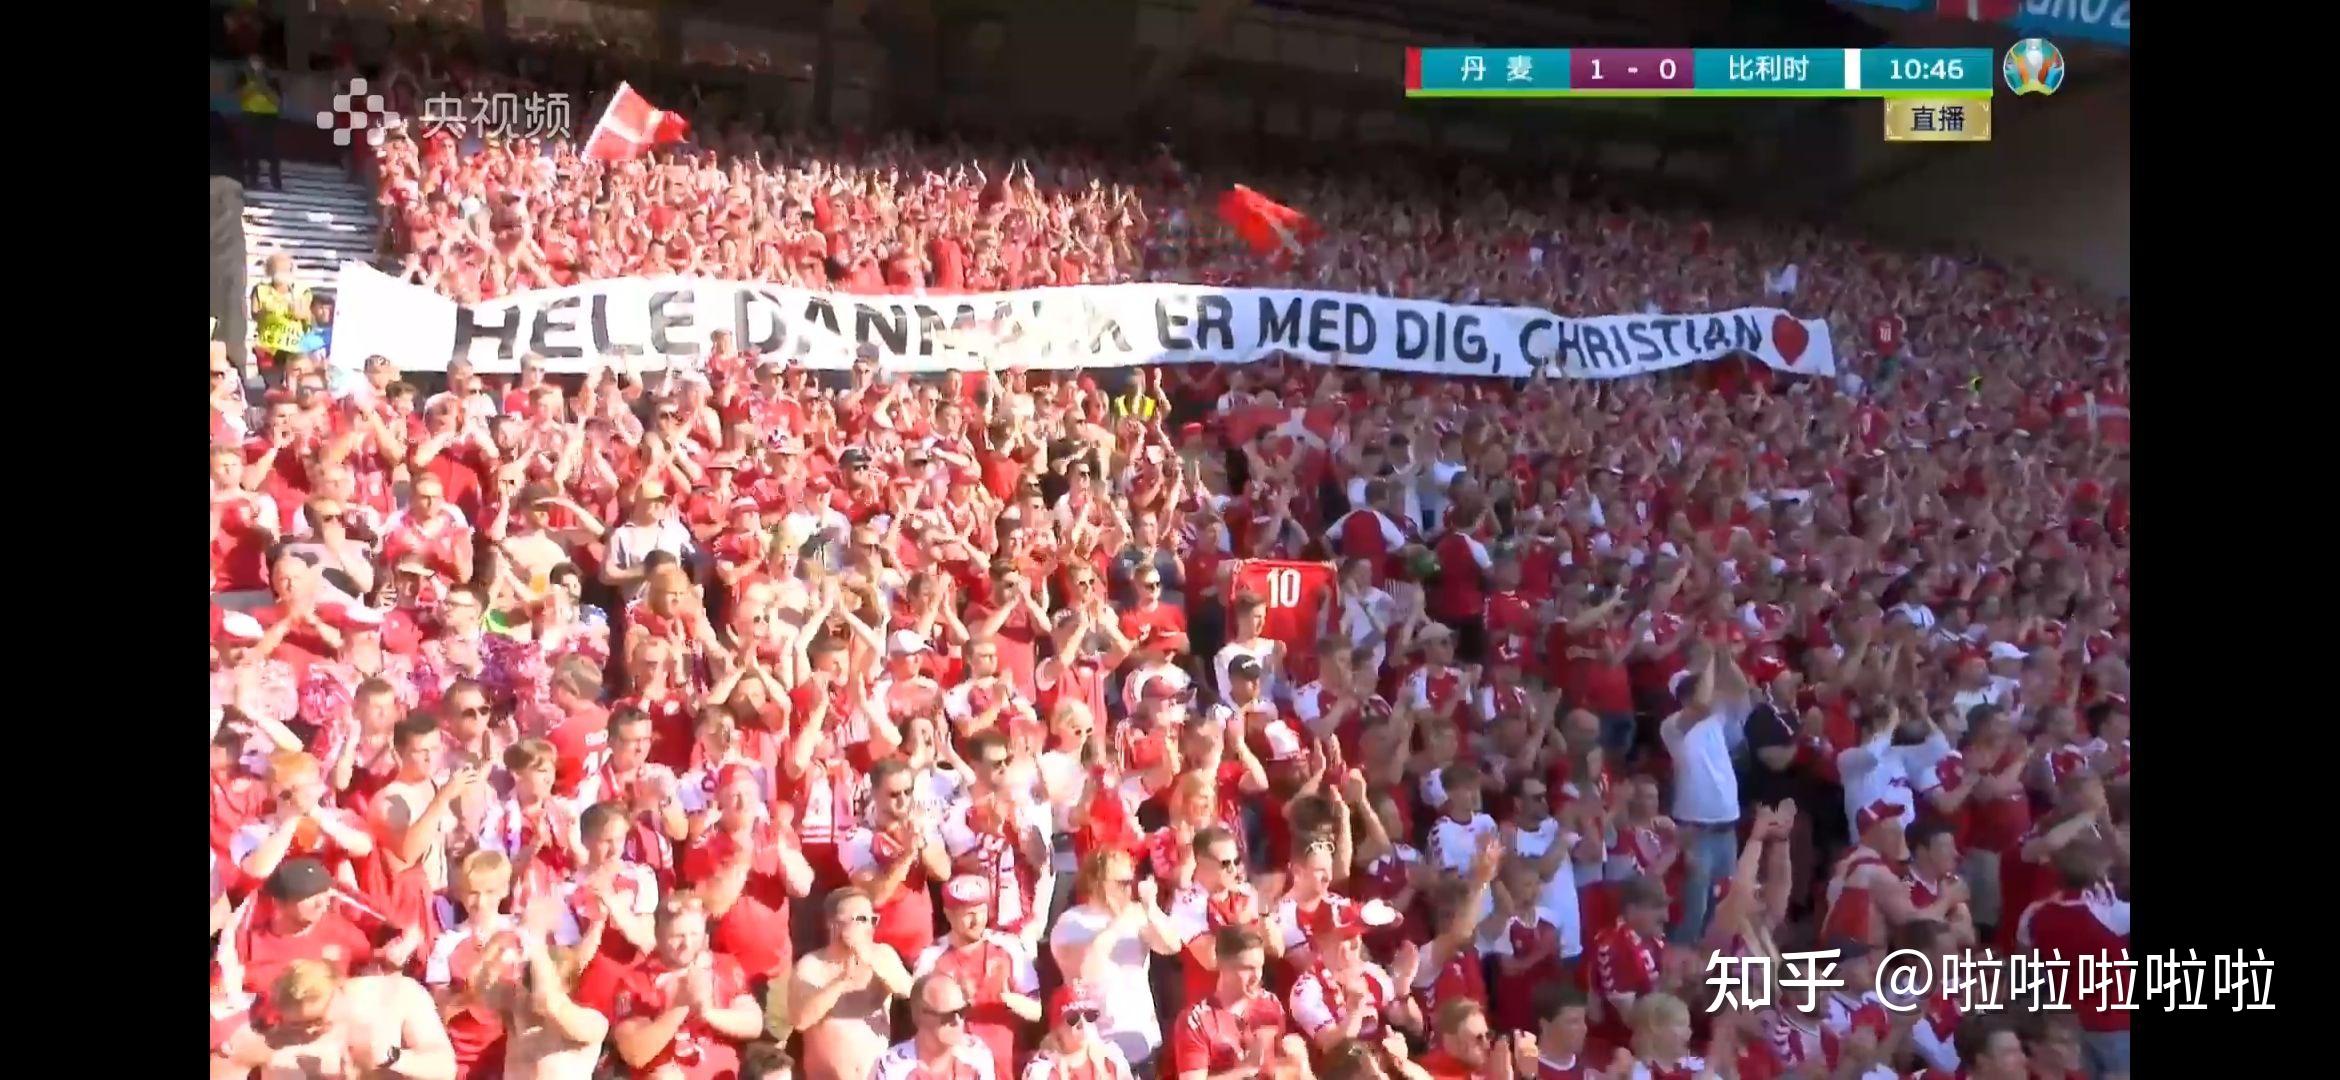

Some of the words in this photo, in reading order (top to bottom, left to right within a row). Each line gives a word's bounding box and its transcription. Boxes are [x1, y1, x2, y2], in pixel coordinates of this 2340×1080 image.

[452, 289, 700, 360] HELE
[1155, 294, 1234, 351] ER
[1256, 295, 1377, 355] MED
[1396, 309, 1502, 374] DIG,
[1518, 313, 1763, 369] CHRISTIAN
[1267, 567, 1301, 609] 10
